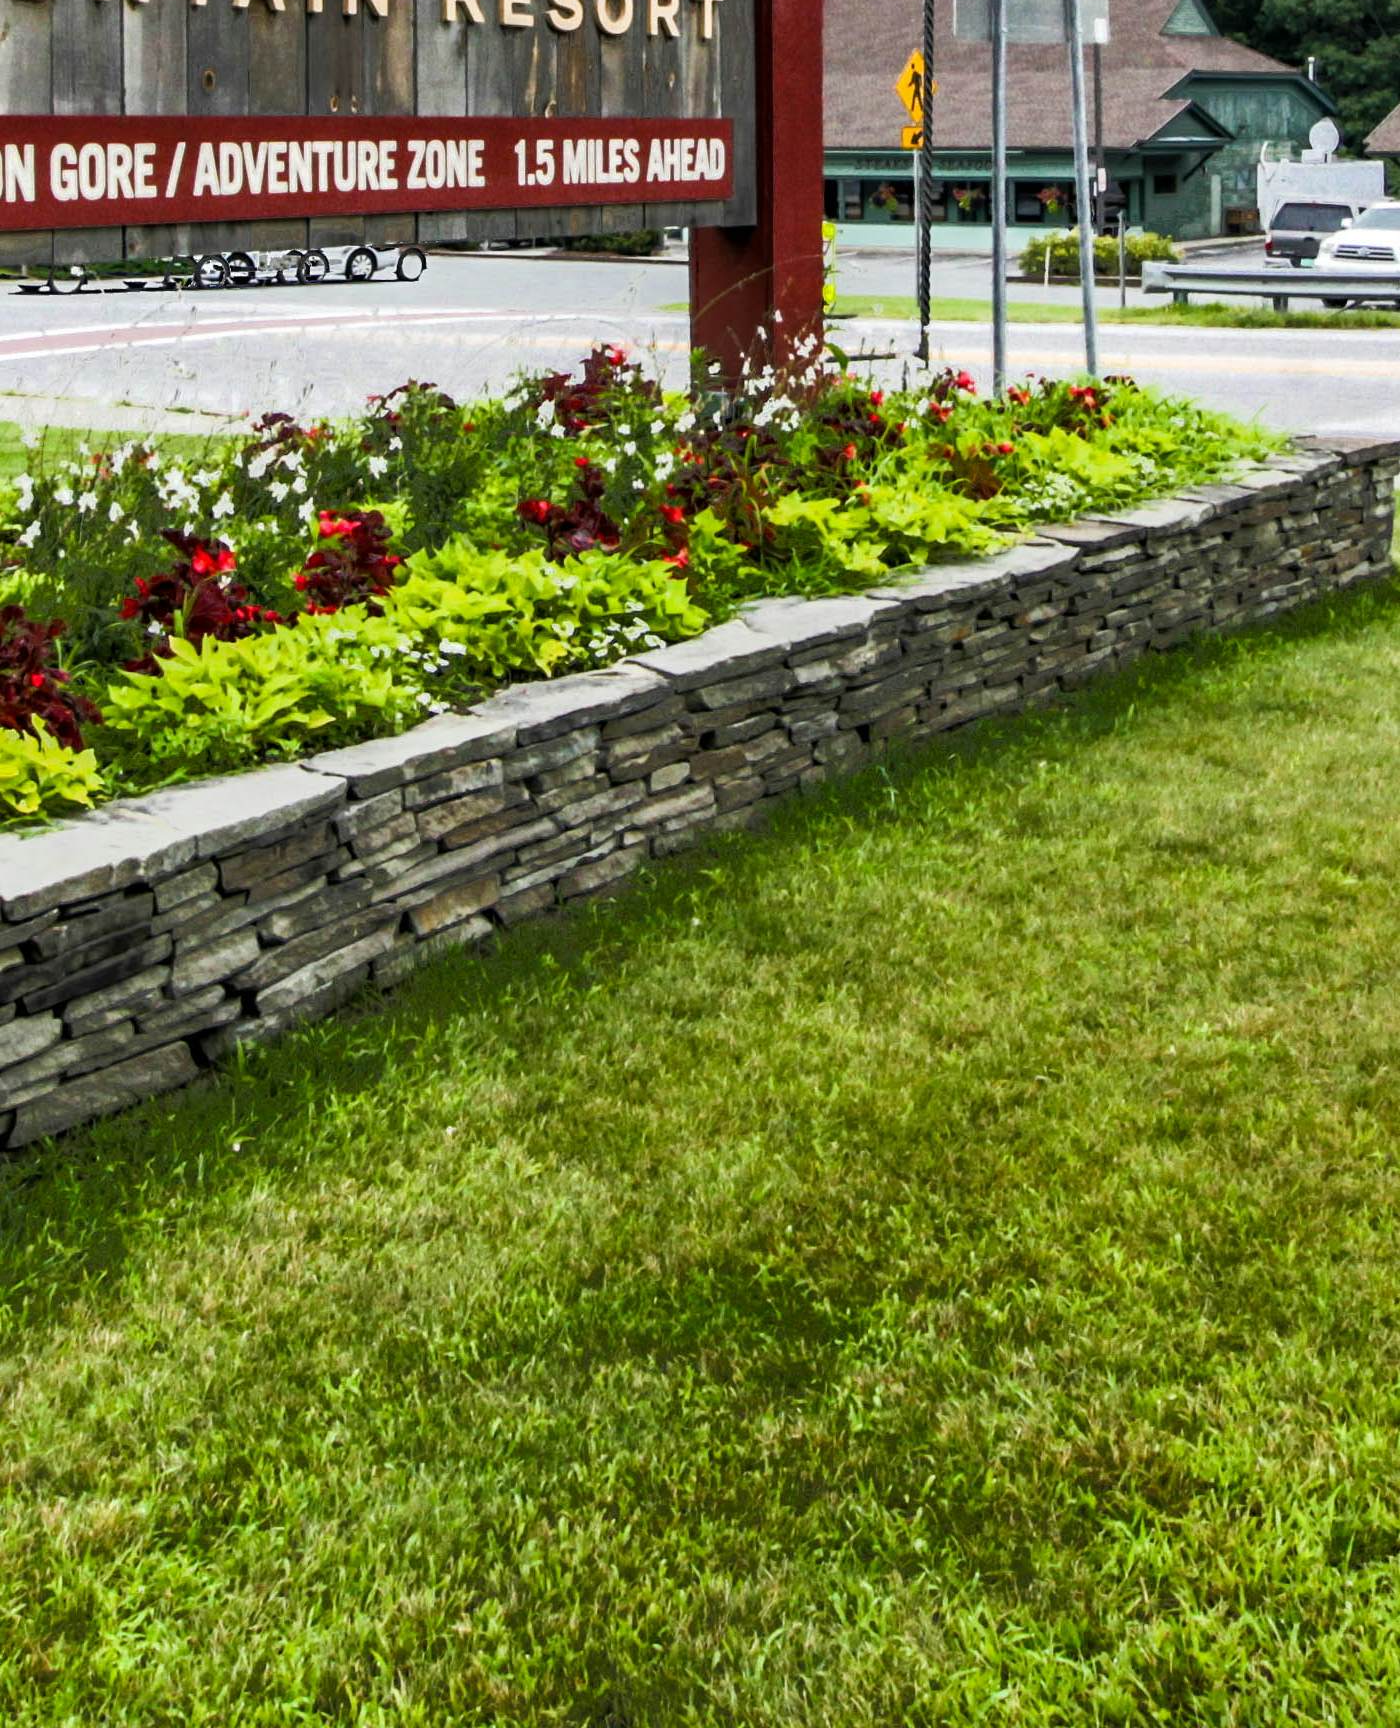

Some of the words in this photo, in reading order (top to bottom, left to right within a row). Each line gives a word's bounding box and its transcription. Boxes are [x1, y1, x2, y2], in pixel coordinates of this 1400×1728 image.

[0, 143, 36, 202] N
[50, 143, 158, 201] GORE
[192, 140, 399, 196] ADVENTURE
[407, 139, 486, 190] ZONE
[514, 138, 555, 186] 1.5
[562, 138, 641, 184] MILES
[646, 138, 726, 183] AHEAD
